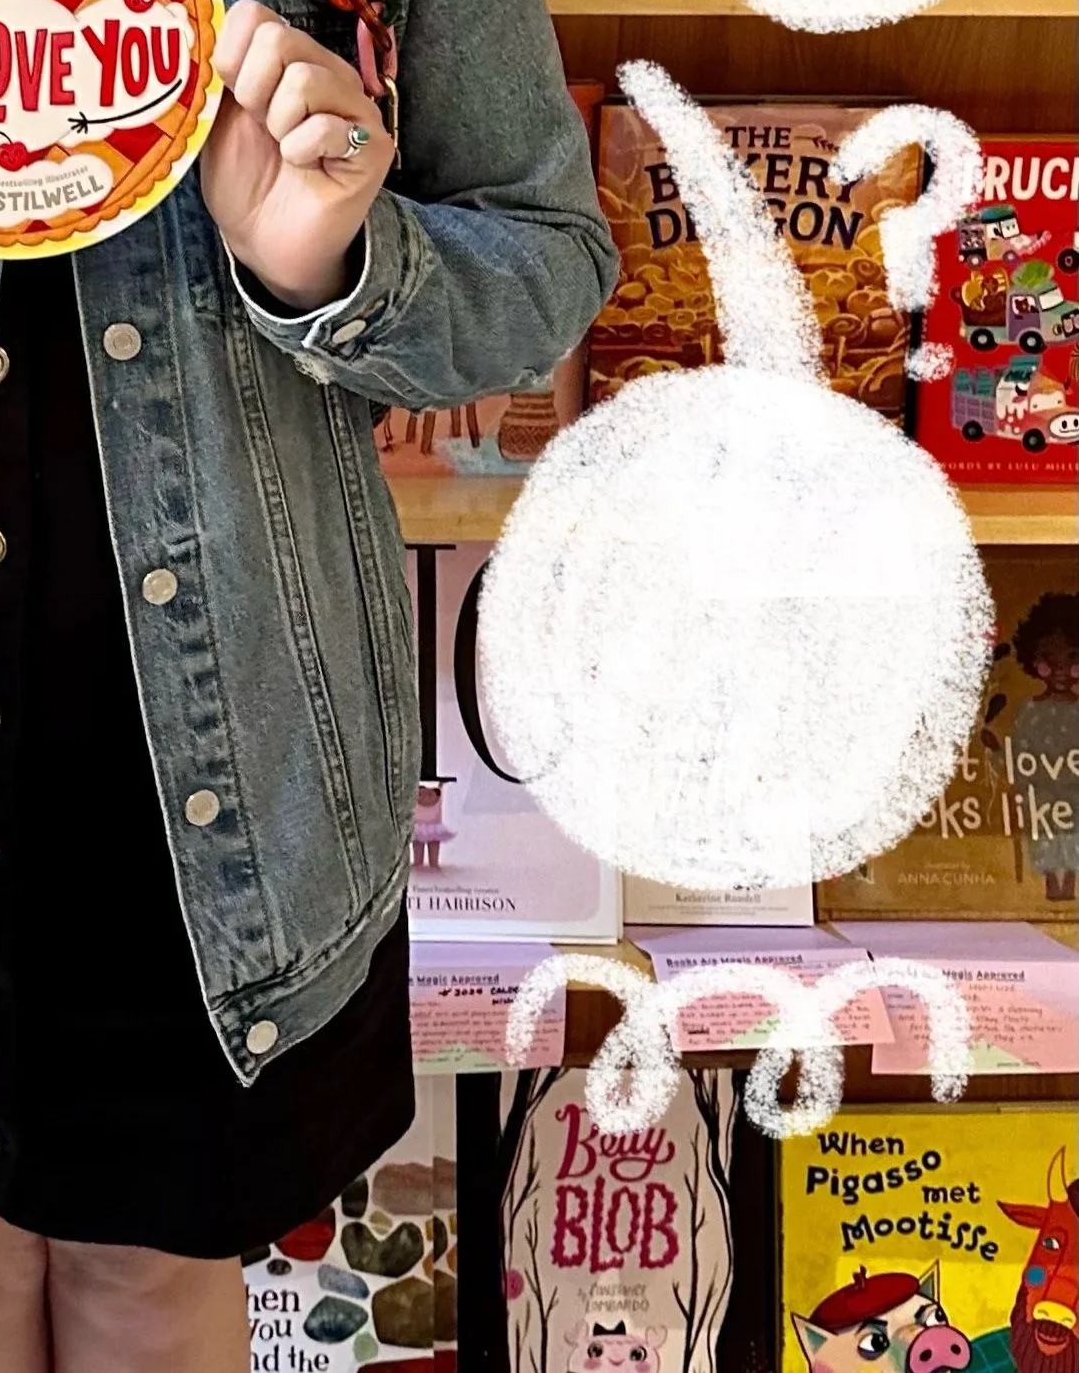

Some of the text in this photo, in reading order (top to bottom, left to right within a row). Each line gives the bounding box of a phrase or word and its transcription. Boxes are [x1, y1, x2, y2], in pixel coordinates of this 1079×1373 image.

[83, 19, 181, 108] YOU
[725, 125, 792, 149] THE
[644, 153, 865, 204] BKERY
[645, 198, 864, 251] DGON
[1002, 783, 1074, 841] like
[898, 873, 995, 885] ANNA CUNHA
[429, 897, 516, 911] HARRISON
[675, 893, 761, 903] Katherine Rundell
[666, 957, 698, 967] Books
[754, 954, 803, 965] Approved
[417, 973, 500, 987] Magic Approved
[976, 969, 1025, 982] Approved
[817, 1131, 904, 1156] When
[806, 1150, 941, 1206] Pigasso
[921, 1182, 980, 1204] met
[551, 1174, 679, 1274] BLOB
[841, 1211, 999, 1262] Mootisse
[288, 1345, 330, 1373] the
